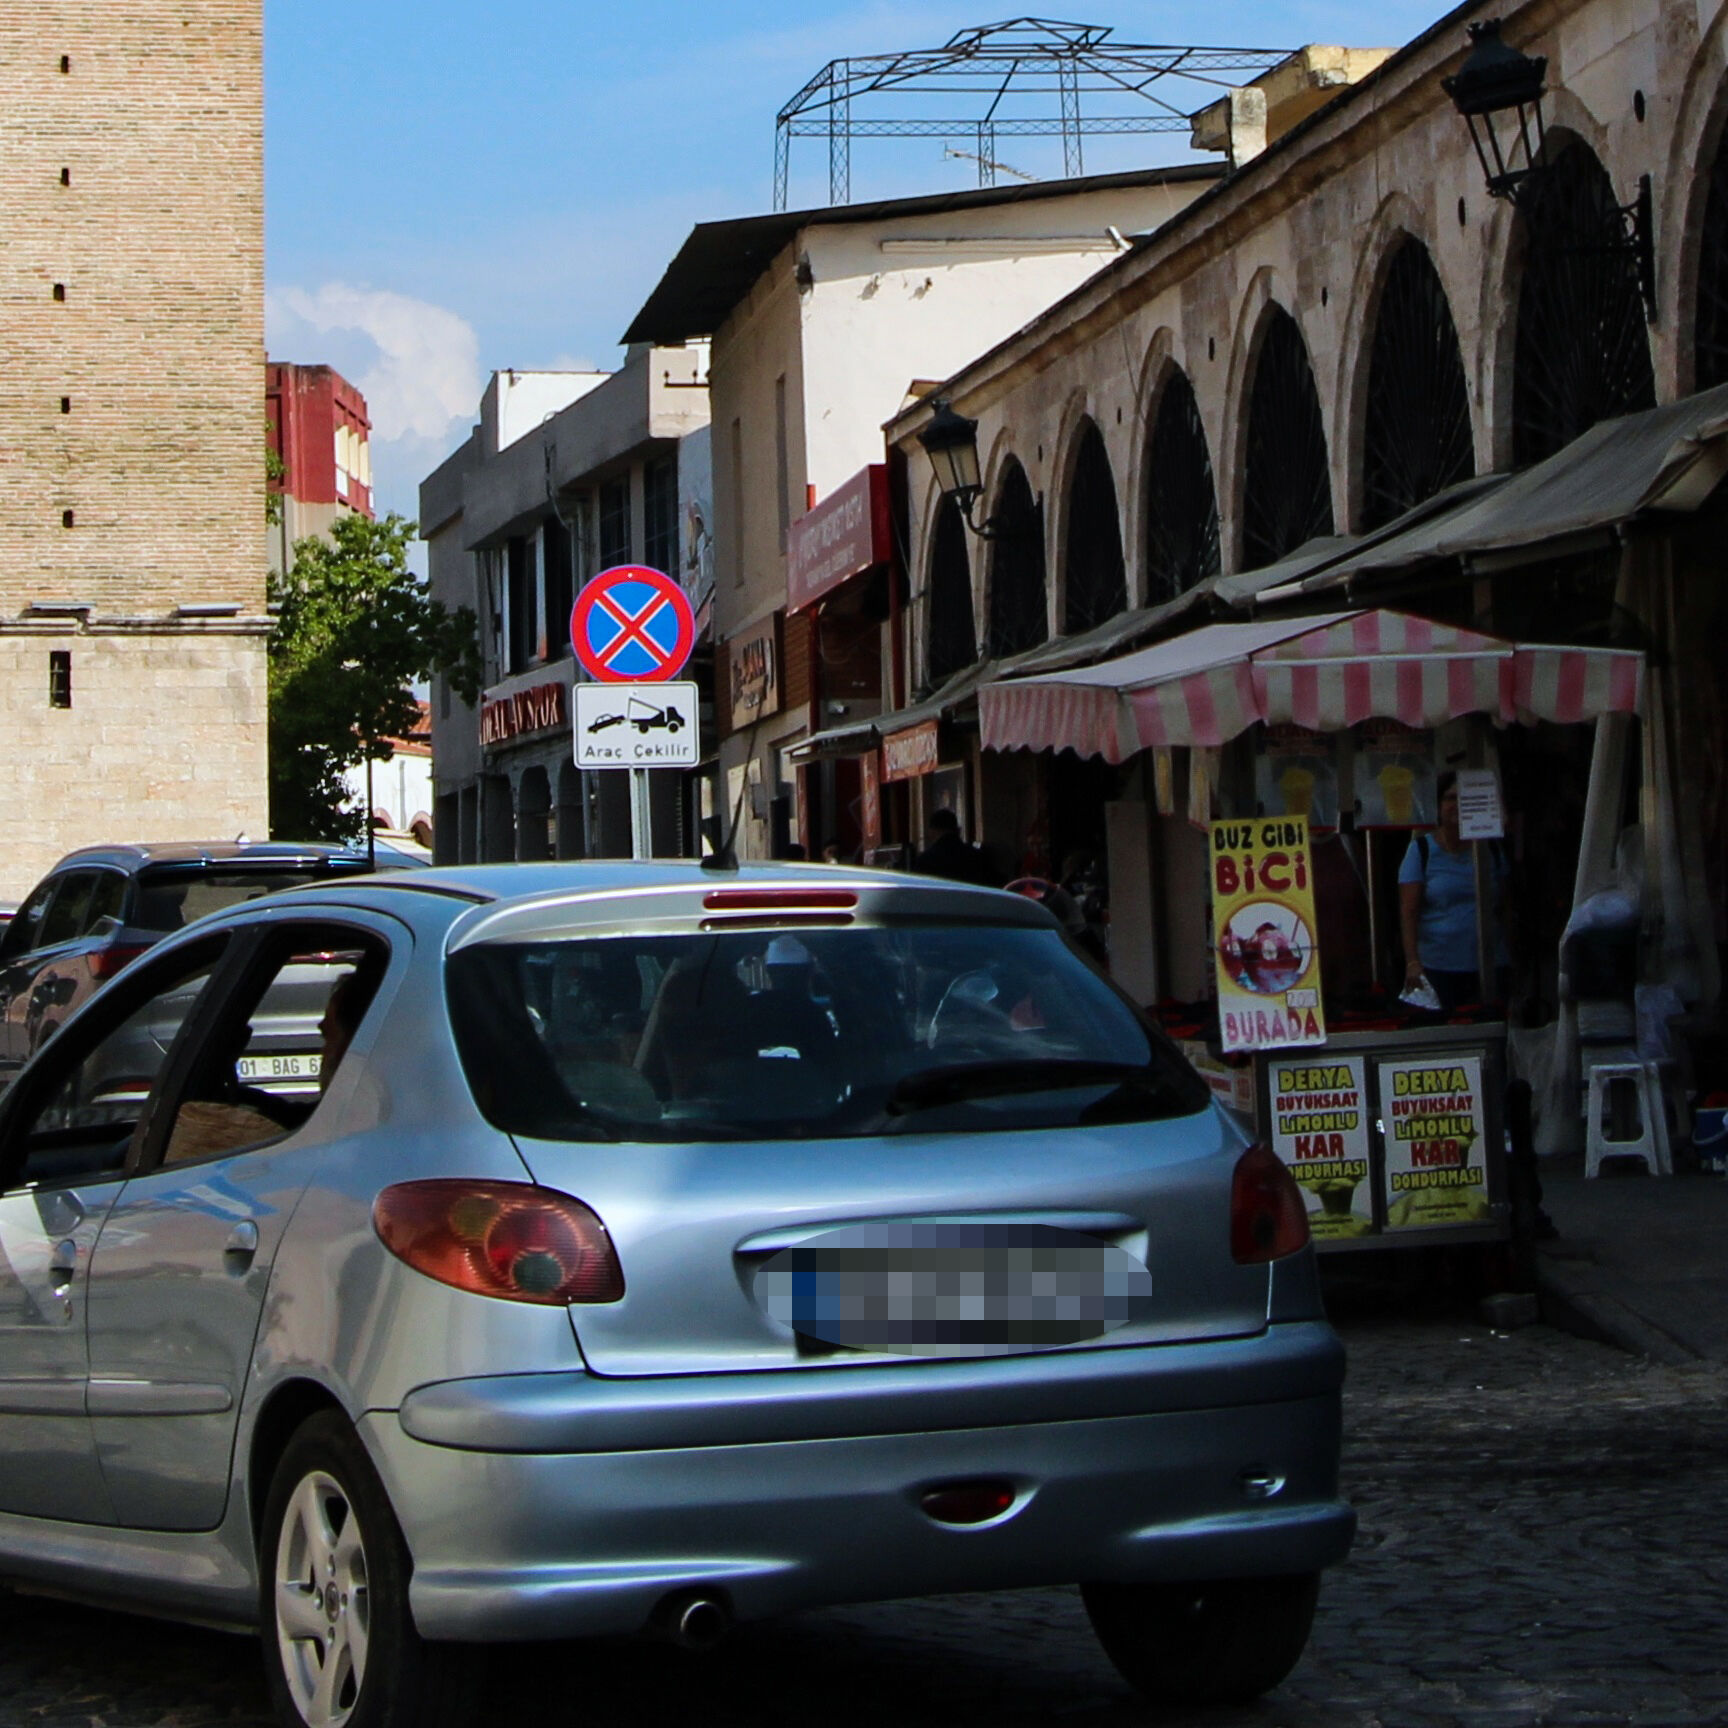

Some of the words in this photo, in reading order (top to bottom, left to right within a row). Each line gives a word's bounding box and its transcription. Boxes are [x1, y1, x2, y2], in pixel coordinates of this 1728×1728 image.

[585, 745, 623, 758] Araç
[633, 744, 689, 758] Çekilir
[1215, 826, 1253, 850] BUZ
[1225, 1008, 1320, 1045] BURADA
[240, 1060, 256, 1075] 01
[272, 1058, 300, 1074] BAG
[1279, 1065, 1355, 1092] DERYA
[1393, 1067, 1469, 1096] DERYA
[1295, 1133, 1344, 1160] KAR
[1411, 1139, 1462, 1167] KAR
[1392, 1167, 1483, 1192] DONDURMASI
